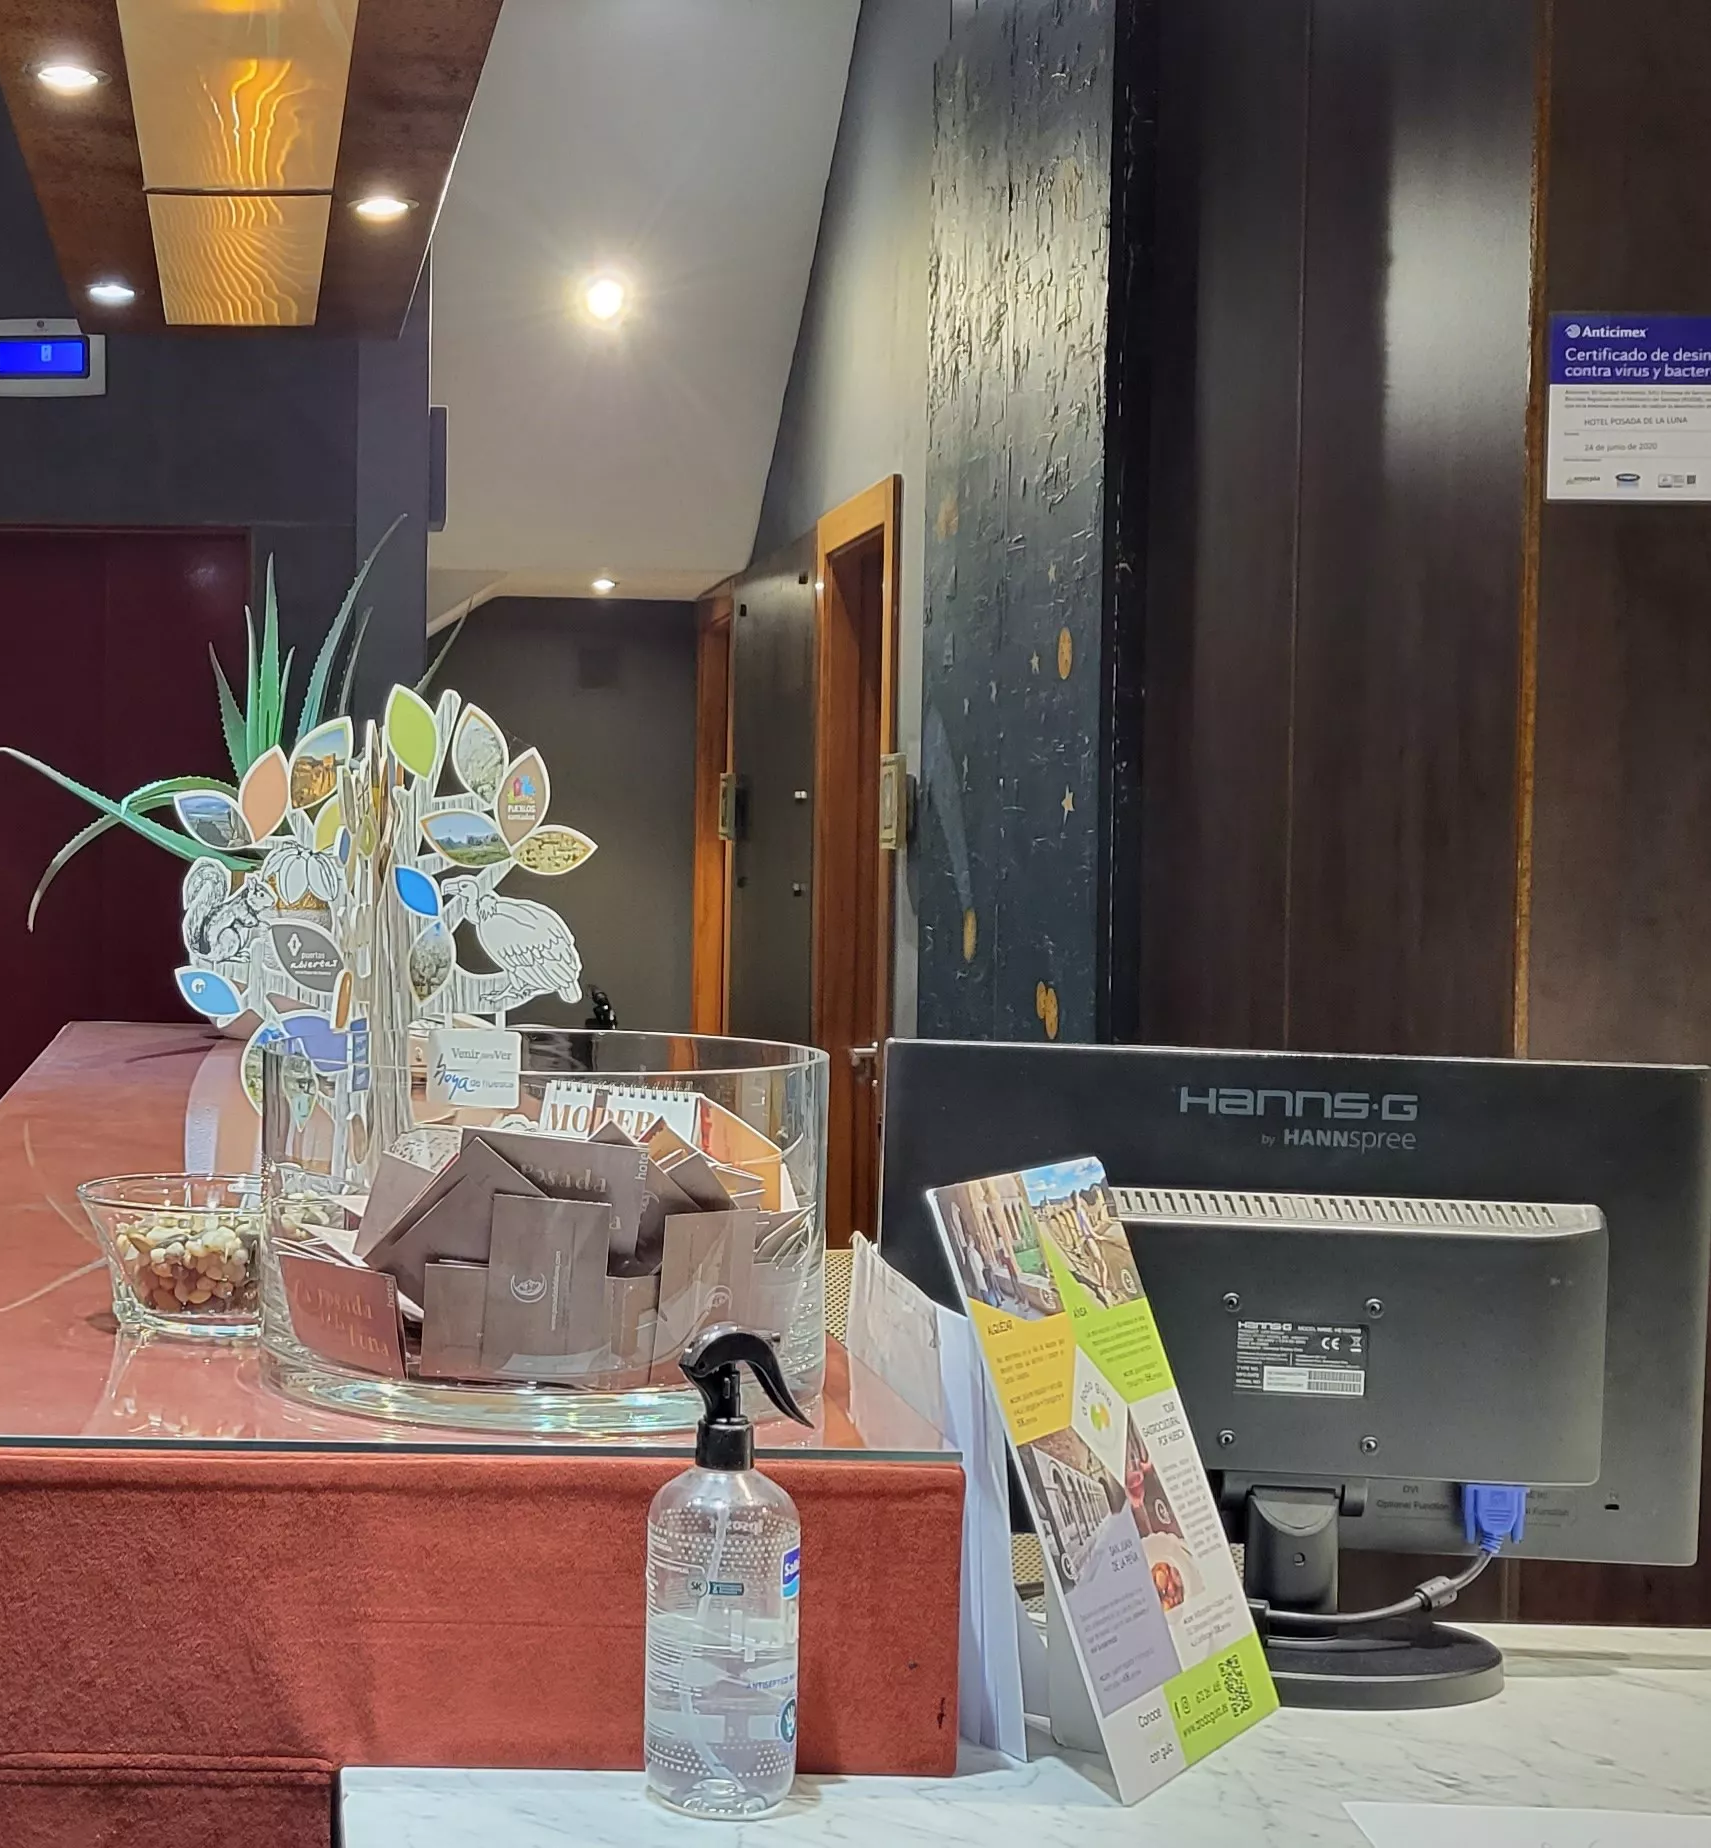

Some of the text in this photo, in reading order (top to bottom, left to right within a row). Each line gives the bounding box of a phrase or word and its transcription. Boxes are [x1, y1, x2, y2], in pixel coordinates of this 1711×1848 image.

[1581, 325, 1646, 338] Anticimex
[1565, 347, 1647, 361] Certificado
[1650, 348, 1669, 361] de
[1565, 366, 1611, 377] contra
[1615, 364, 1649, 377] virus
[1653, 367, 1661, 380] y
[1584, 417, 1608, 426] HOTEL
[1610, 417, 1641, 425] POSADA
[1643, 417, 1653, 425] DE
[1667, 416, 1688, 424] LUNA
[451, 1047, 480, 1060] Venir
[1261, 1133, 1276, 1147] by
[1403, 1485, 1420, 1494] DVI
[1376, 1500, 1450, 1511] Optional Function
[1137, 1707, 1163, 1728] Conoce
